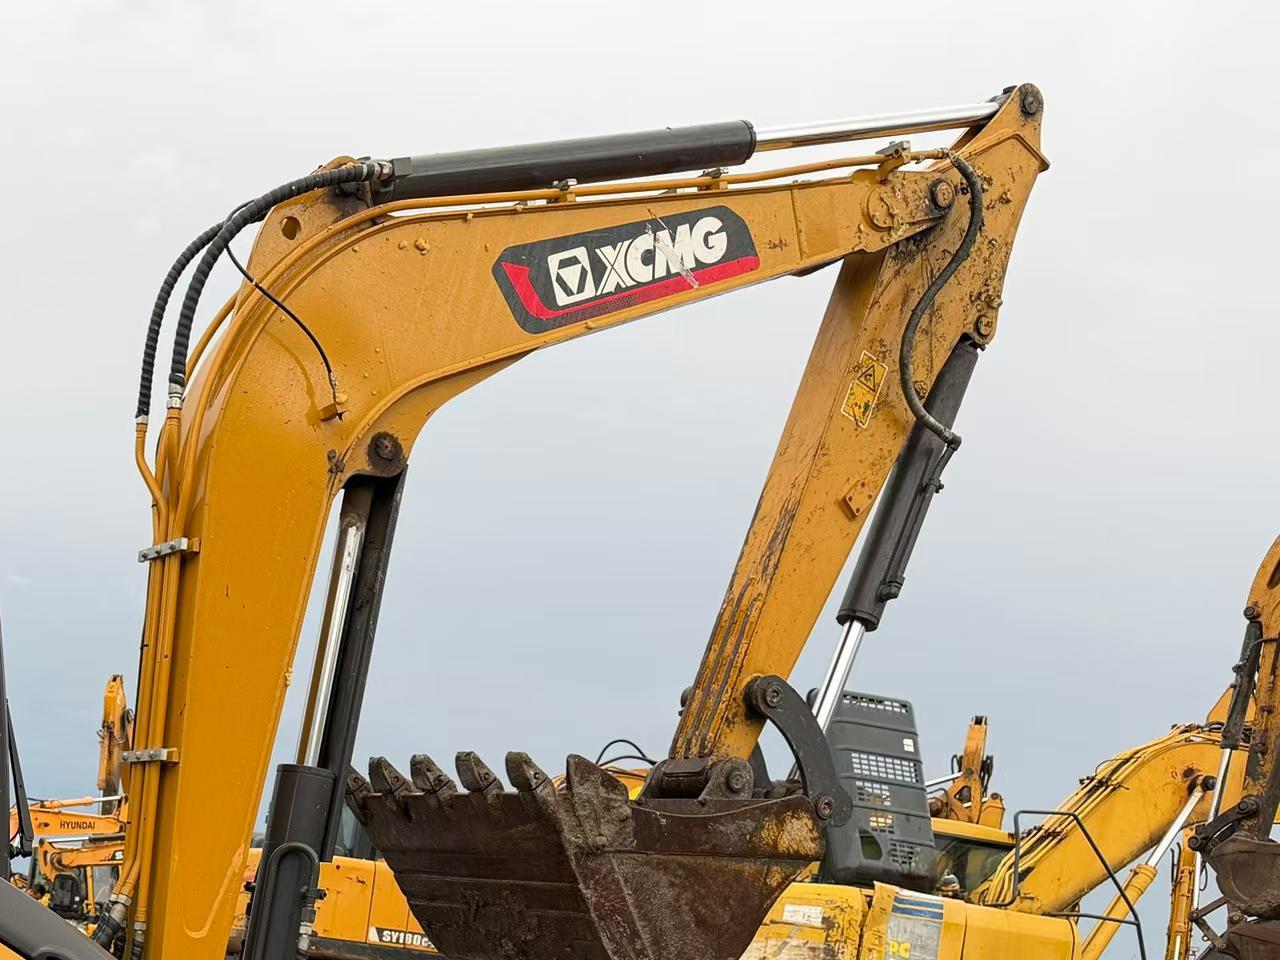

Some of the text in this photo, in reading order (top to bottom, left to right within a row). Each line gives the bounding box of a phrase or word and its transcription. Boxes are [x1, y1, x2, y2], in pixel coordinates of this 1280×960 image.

[595, 216, 728, 296] XCMG
[59, 820, 96, 831] HYUNDAI
[888, 940, 912, 958] PC
